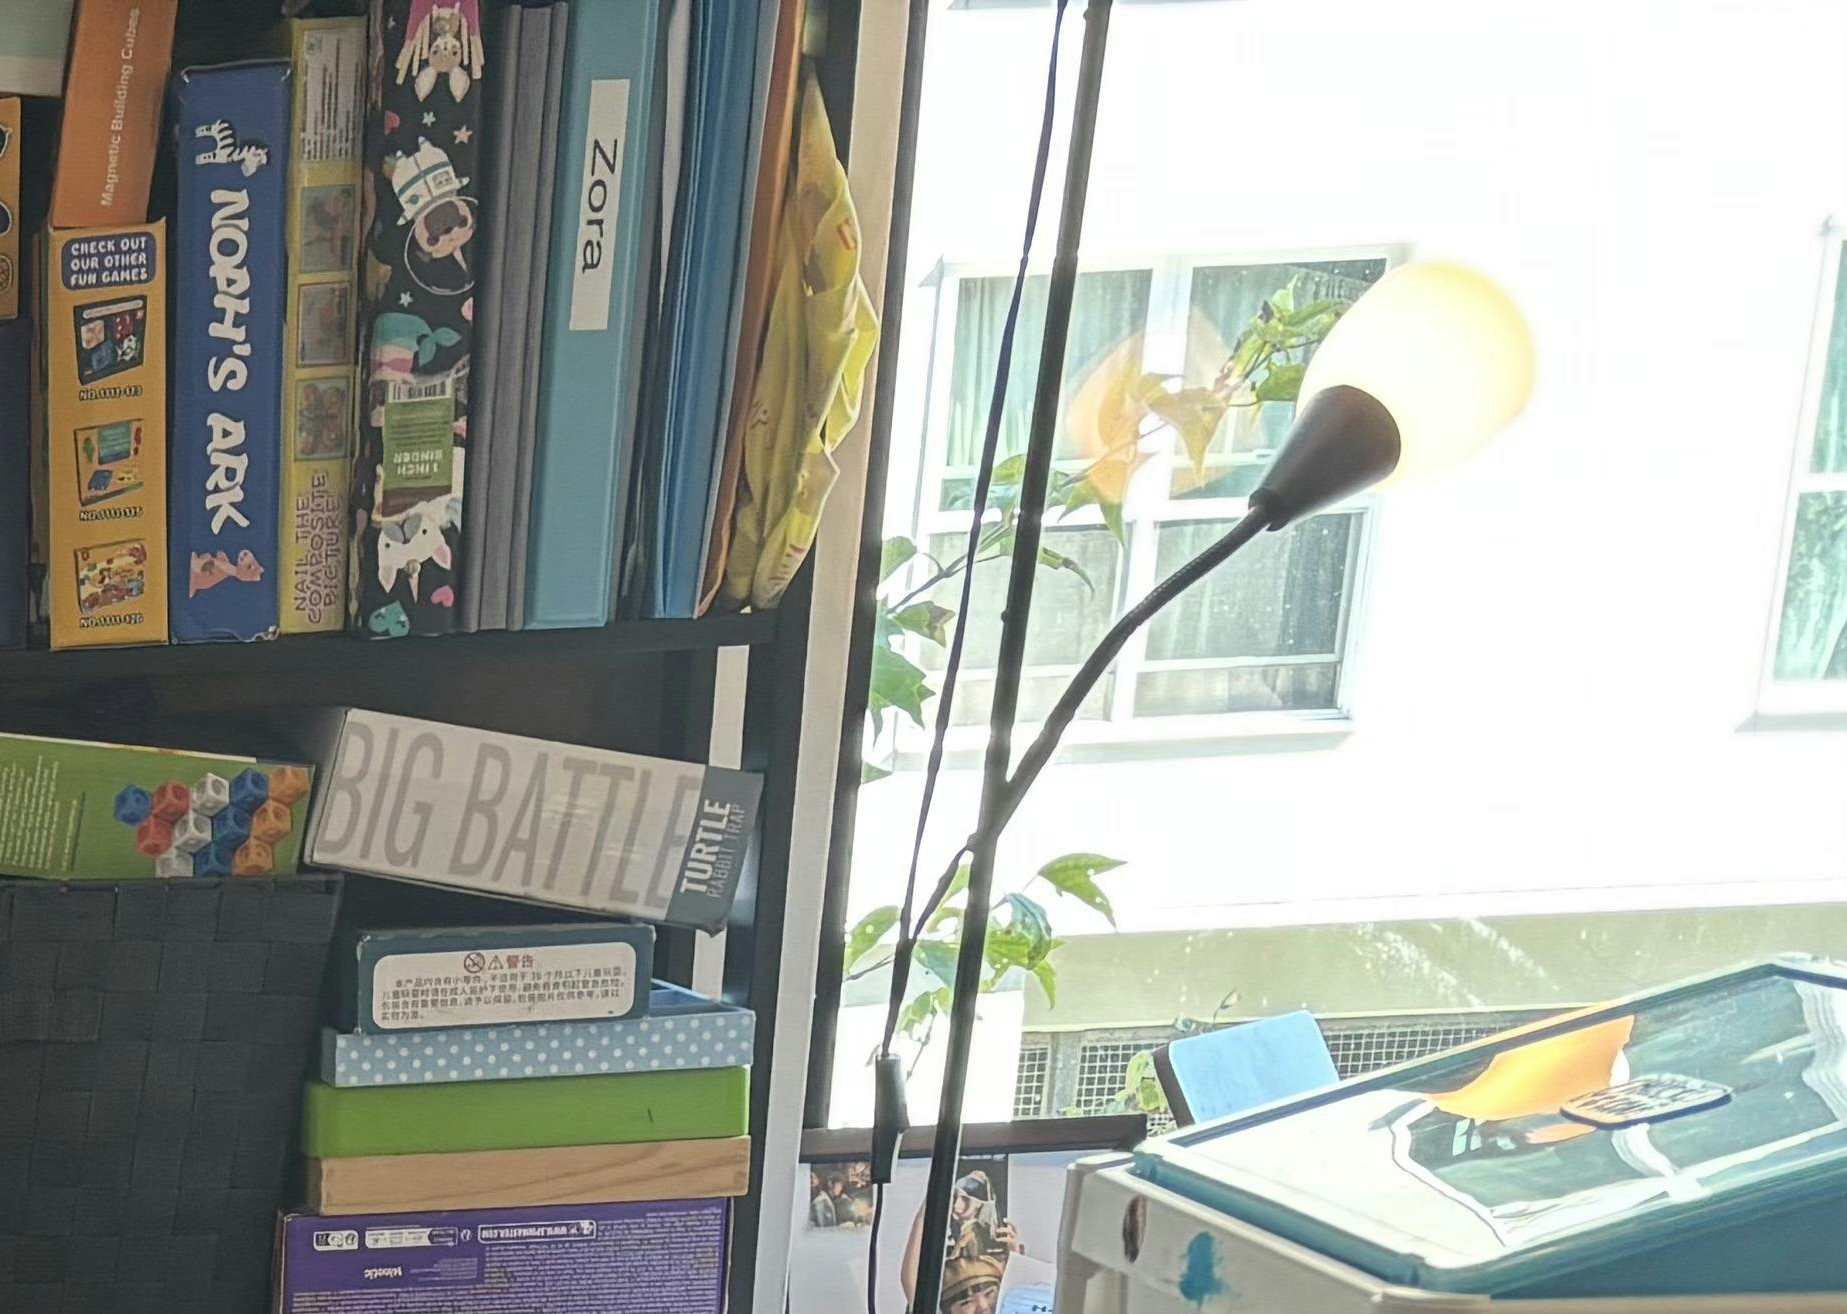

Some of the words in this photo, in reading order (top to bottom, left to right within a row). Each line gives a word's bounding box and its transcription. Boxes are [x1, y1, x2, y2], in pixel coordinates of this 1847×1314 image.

[122, 8, 140, 59] Cubes
[111, 63, 134, 132] Building
[101, 133, 121, 206] Magnetic
[581, 138, 619, 276] Zora
[70, 272, 97, 287] FUN
[102, 267, 148, 284] GAMES
[71, 240, 116, 255] CHECK
[120, 236, 147, 253] OUT
[71, 256, 99, 270] OUR
[104, 252, 147, 268] OTHER
[208, 188, 252, 392] NOAH'S
[205, 413, 250, 535] ARK
[295, 496, 310, 544] THE
[307, 470, 329, 624] COMPOSITE
[323, 495, 341, 607] PICTURE
[318, 721, 445, 868] BIG
[448, 742, 703, 909] BATTLE
[680, 799, 731, 896] TURTLE
[707, 840, 732, 899] RABBIT
[726, 803, 744, 840] TRAP
[506, 953, 535, 969] 警告
